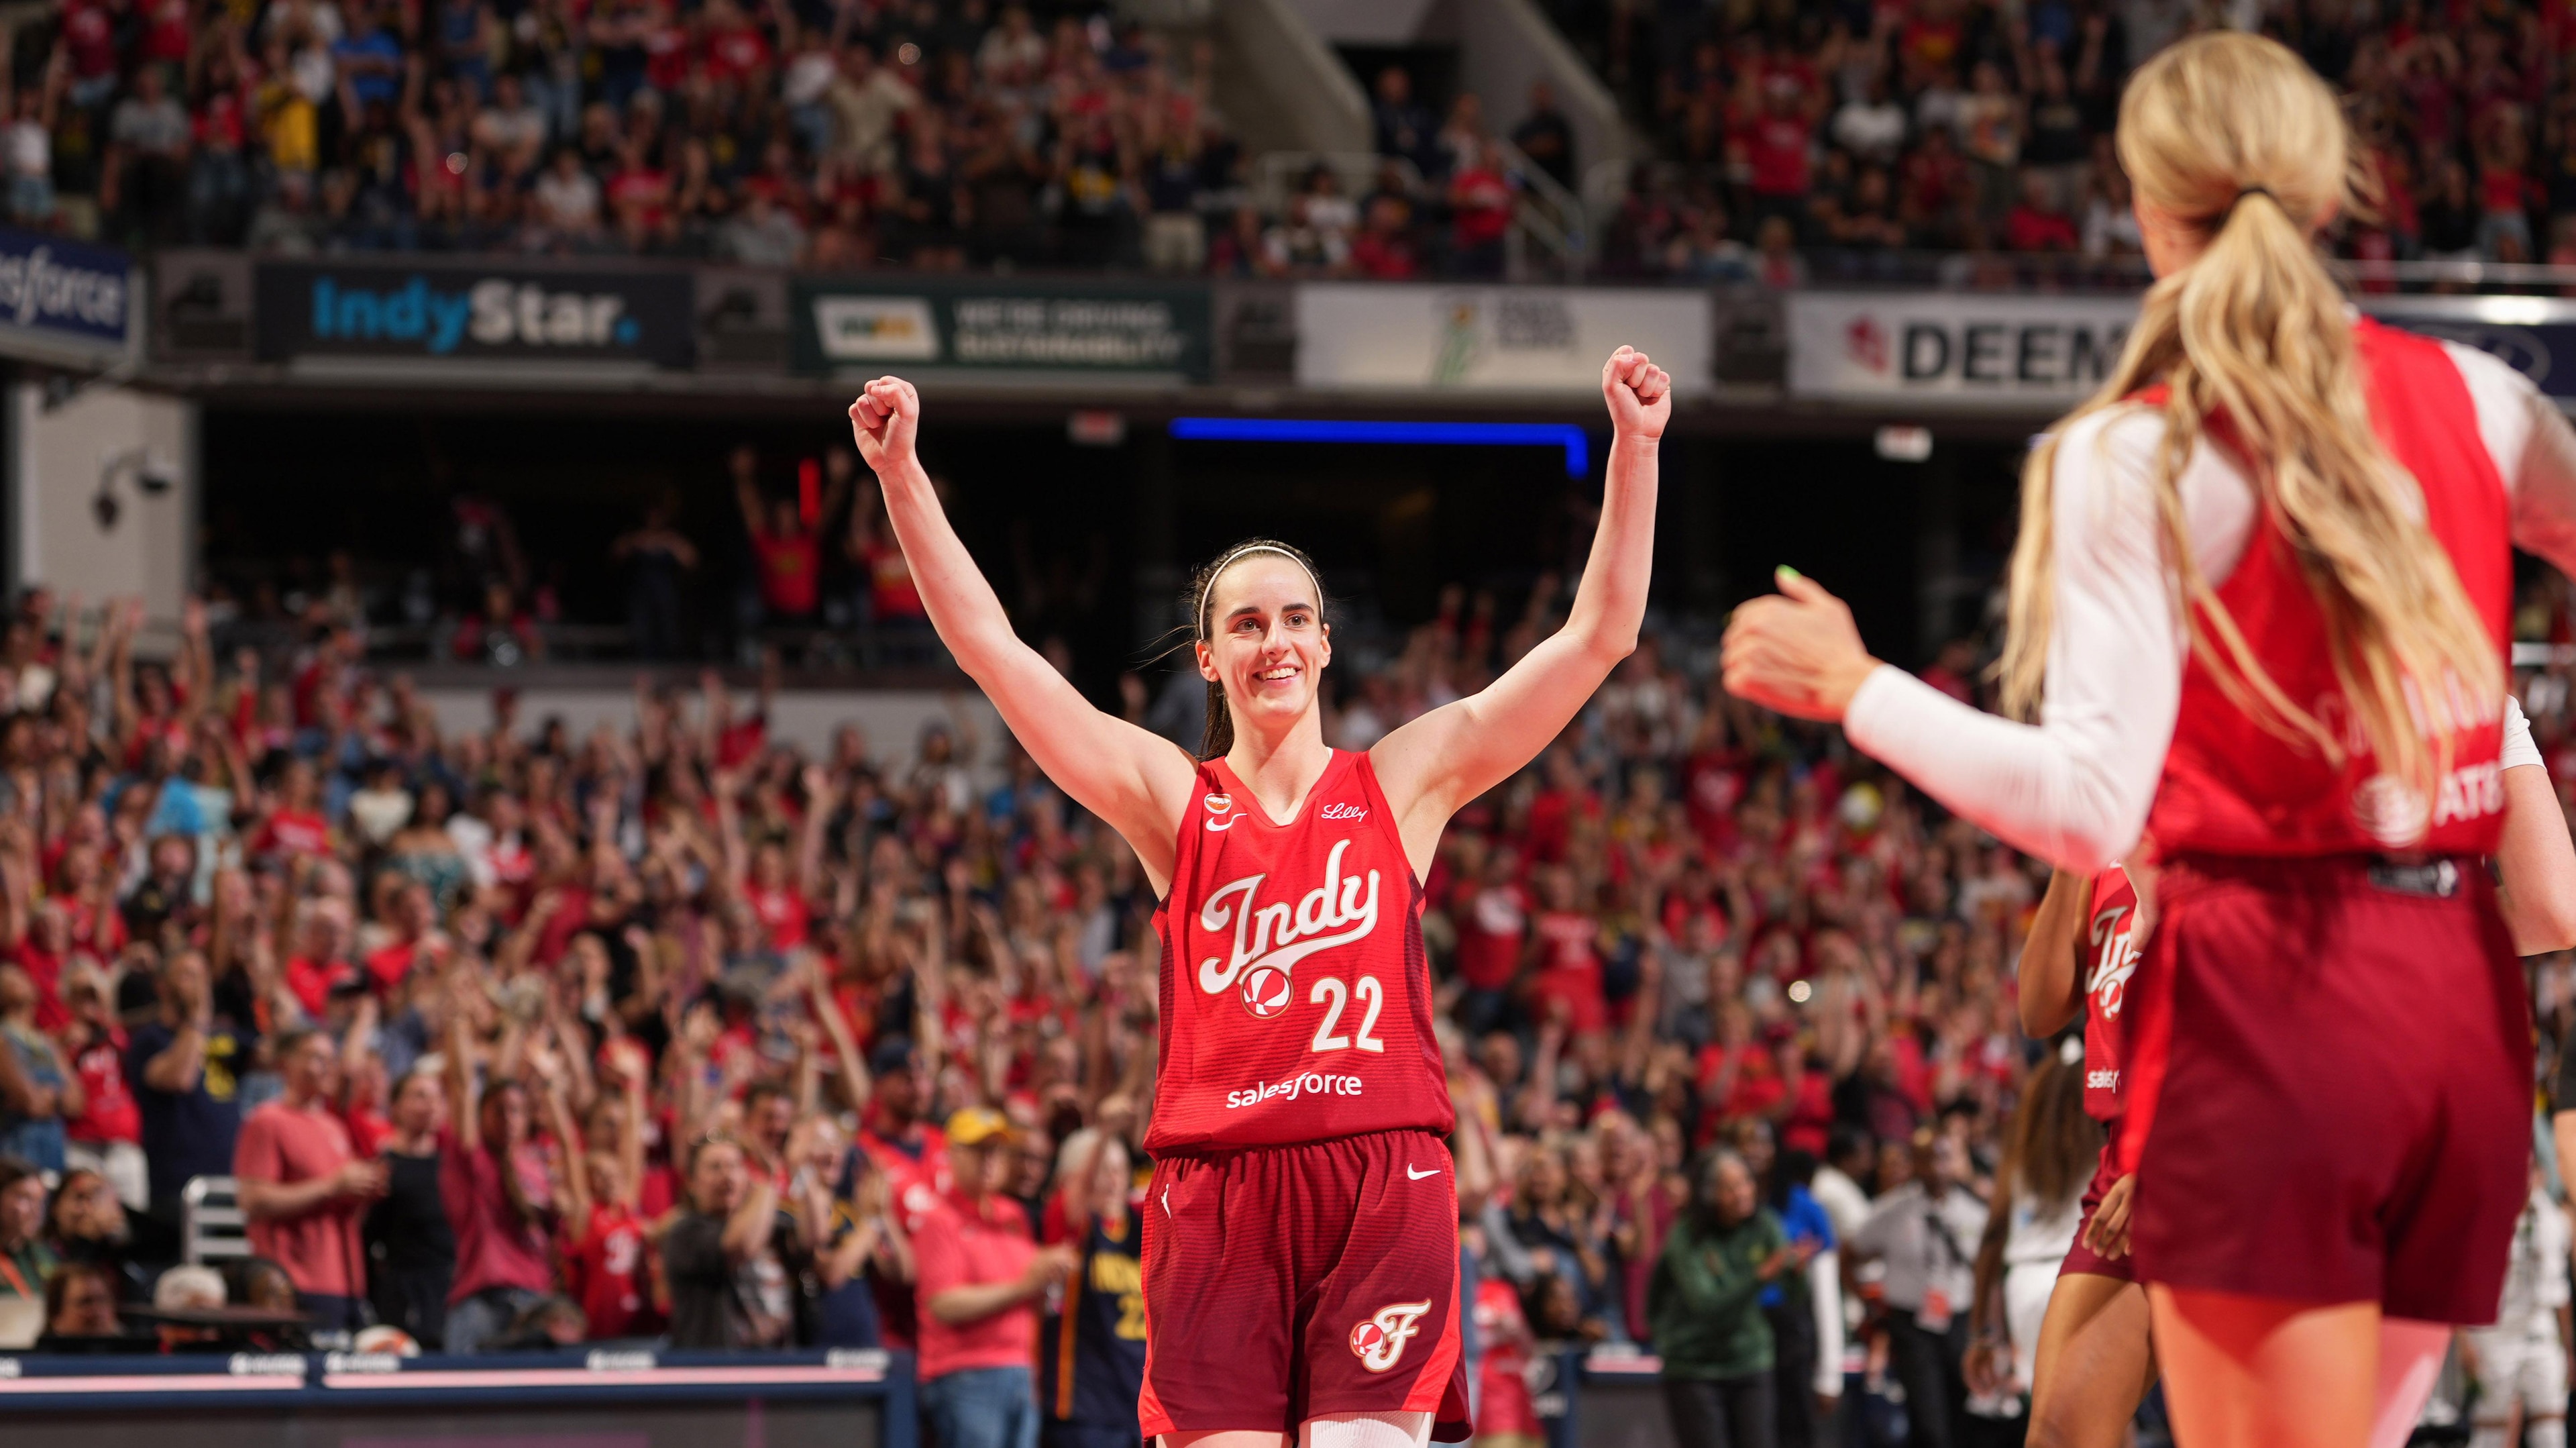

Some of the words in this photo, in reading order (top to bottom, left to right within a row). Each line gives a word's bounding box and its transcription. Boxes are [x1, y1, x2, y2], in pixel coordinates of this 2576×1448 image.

[0, 246, 121, 327] sforce
[311, 275, 642, 356] IndyStar.
[1321, 802, 1368, 823] Lilly
[1198, 839, 1381, 995] Indy
[2085, 905, 2143, 994] In
[1309, 973, 1385, 1053] 22
[1225, 1071, 1362, 1108] salesforce
